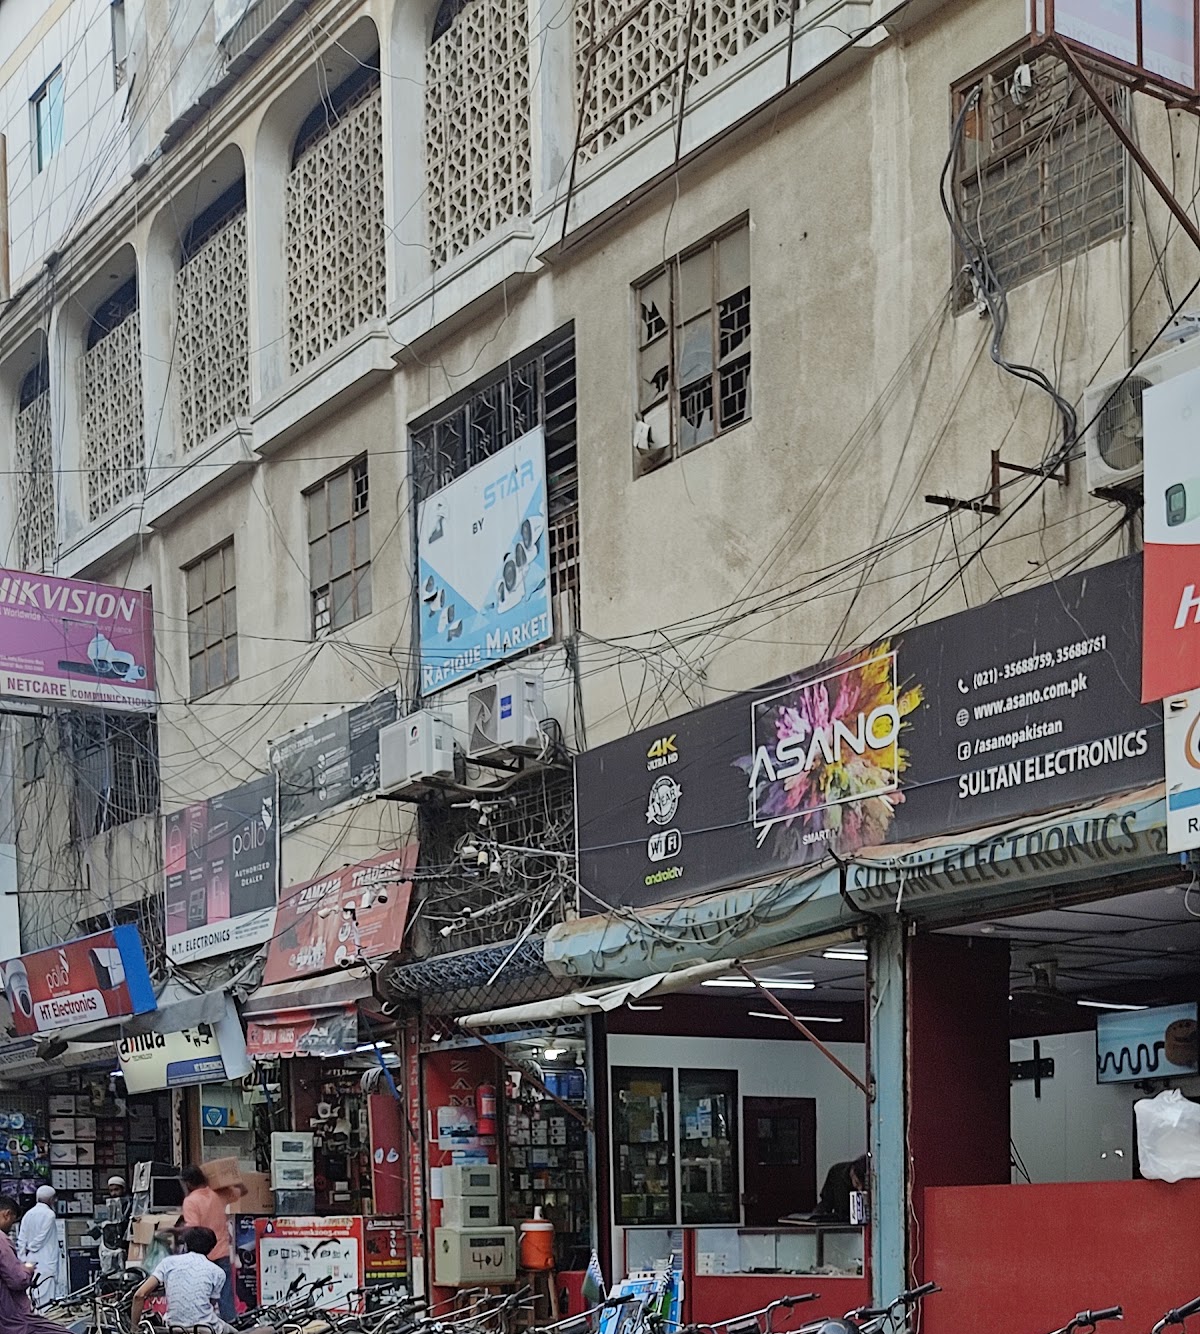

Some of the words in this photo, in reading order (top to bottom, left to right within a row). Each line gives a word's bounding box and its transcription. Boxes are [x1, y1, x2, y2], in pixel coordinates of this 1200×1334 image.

[483, 459, 535, 511] STAR
[472, 517, 485, 535] BY
[423, 645, 482, 689] RAFIQUE
[485, 612, 548, 658] MARKET
[7, 677, 67, 697] NETCARE
[71, 689, 153, 708] COMMUNICATIONS
[973, 672, 1088, 721] www.asano.com.pk
[647, 733, 678, 759] 4K
[749, 704, 900, 788] ASANO
[647, 756, 667, 771] ULTRA
[667, 752, 679, 764] HD
[958, 759, 1021, 799] SULTAN
[1024, 728, 1148, 783] ELECTRONICS
[802, 829, 831, 846] SMART
[946, 811, 1137, 886] ELECTRONICS
[235, 861, 271, 878] AUTHORIZED
[241, 874, 263, 888] DEALER
[172, 941, 185, 956] H.T.
[185, 929, 231, 952] ELECTRONICS
[39, 1004, 52, 1021] HT
[51, 994, 97, 1018] Electronics
